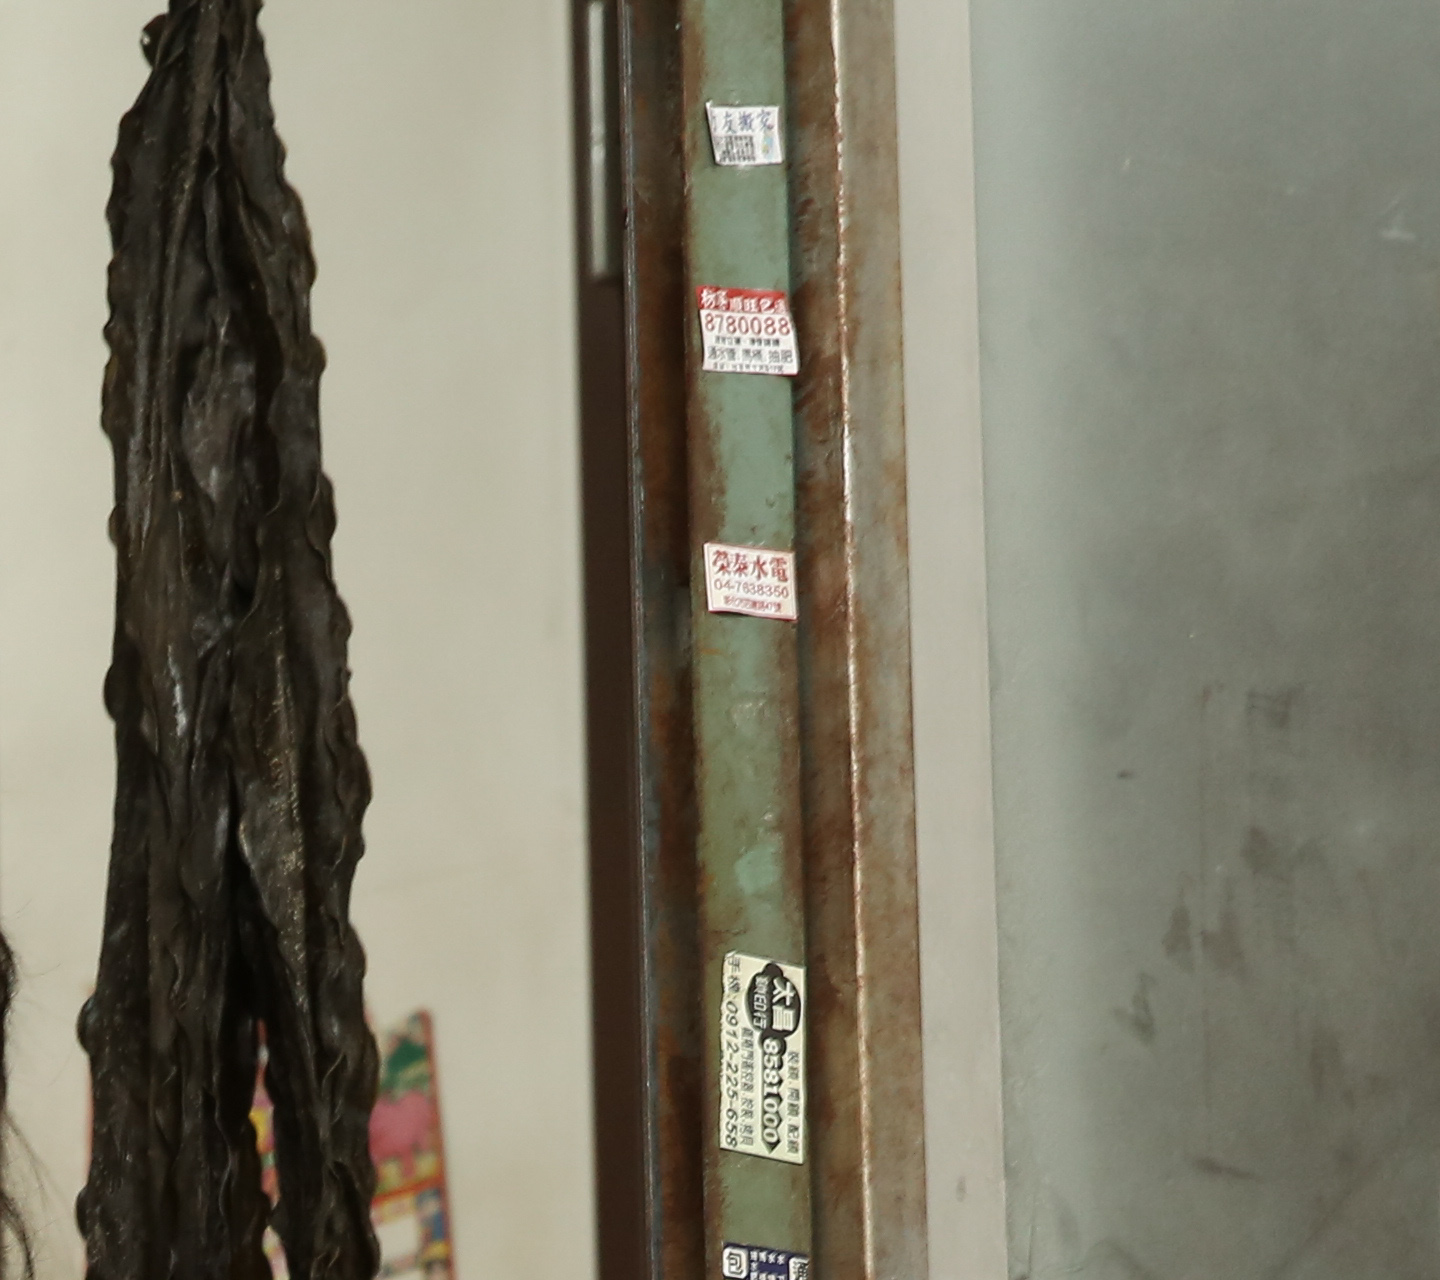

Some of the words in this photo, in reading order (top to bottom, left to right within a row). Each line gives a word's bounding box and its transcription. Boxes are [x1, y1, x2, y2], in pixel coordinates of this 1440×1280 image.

[705, 312, 790, 336] 8780088
[724, 1000, 739, 1149] 0912-225-658
[762, 1037, 782, 1144] 8581000
